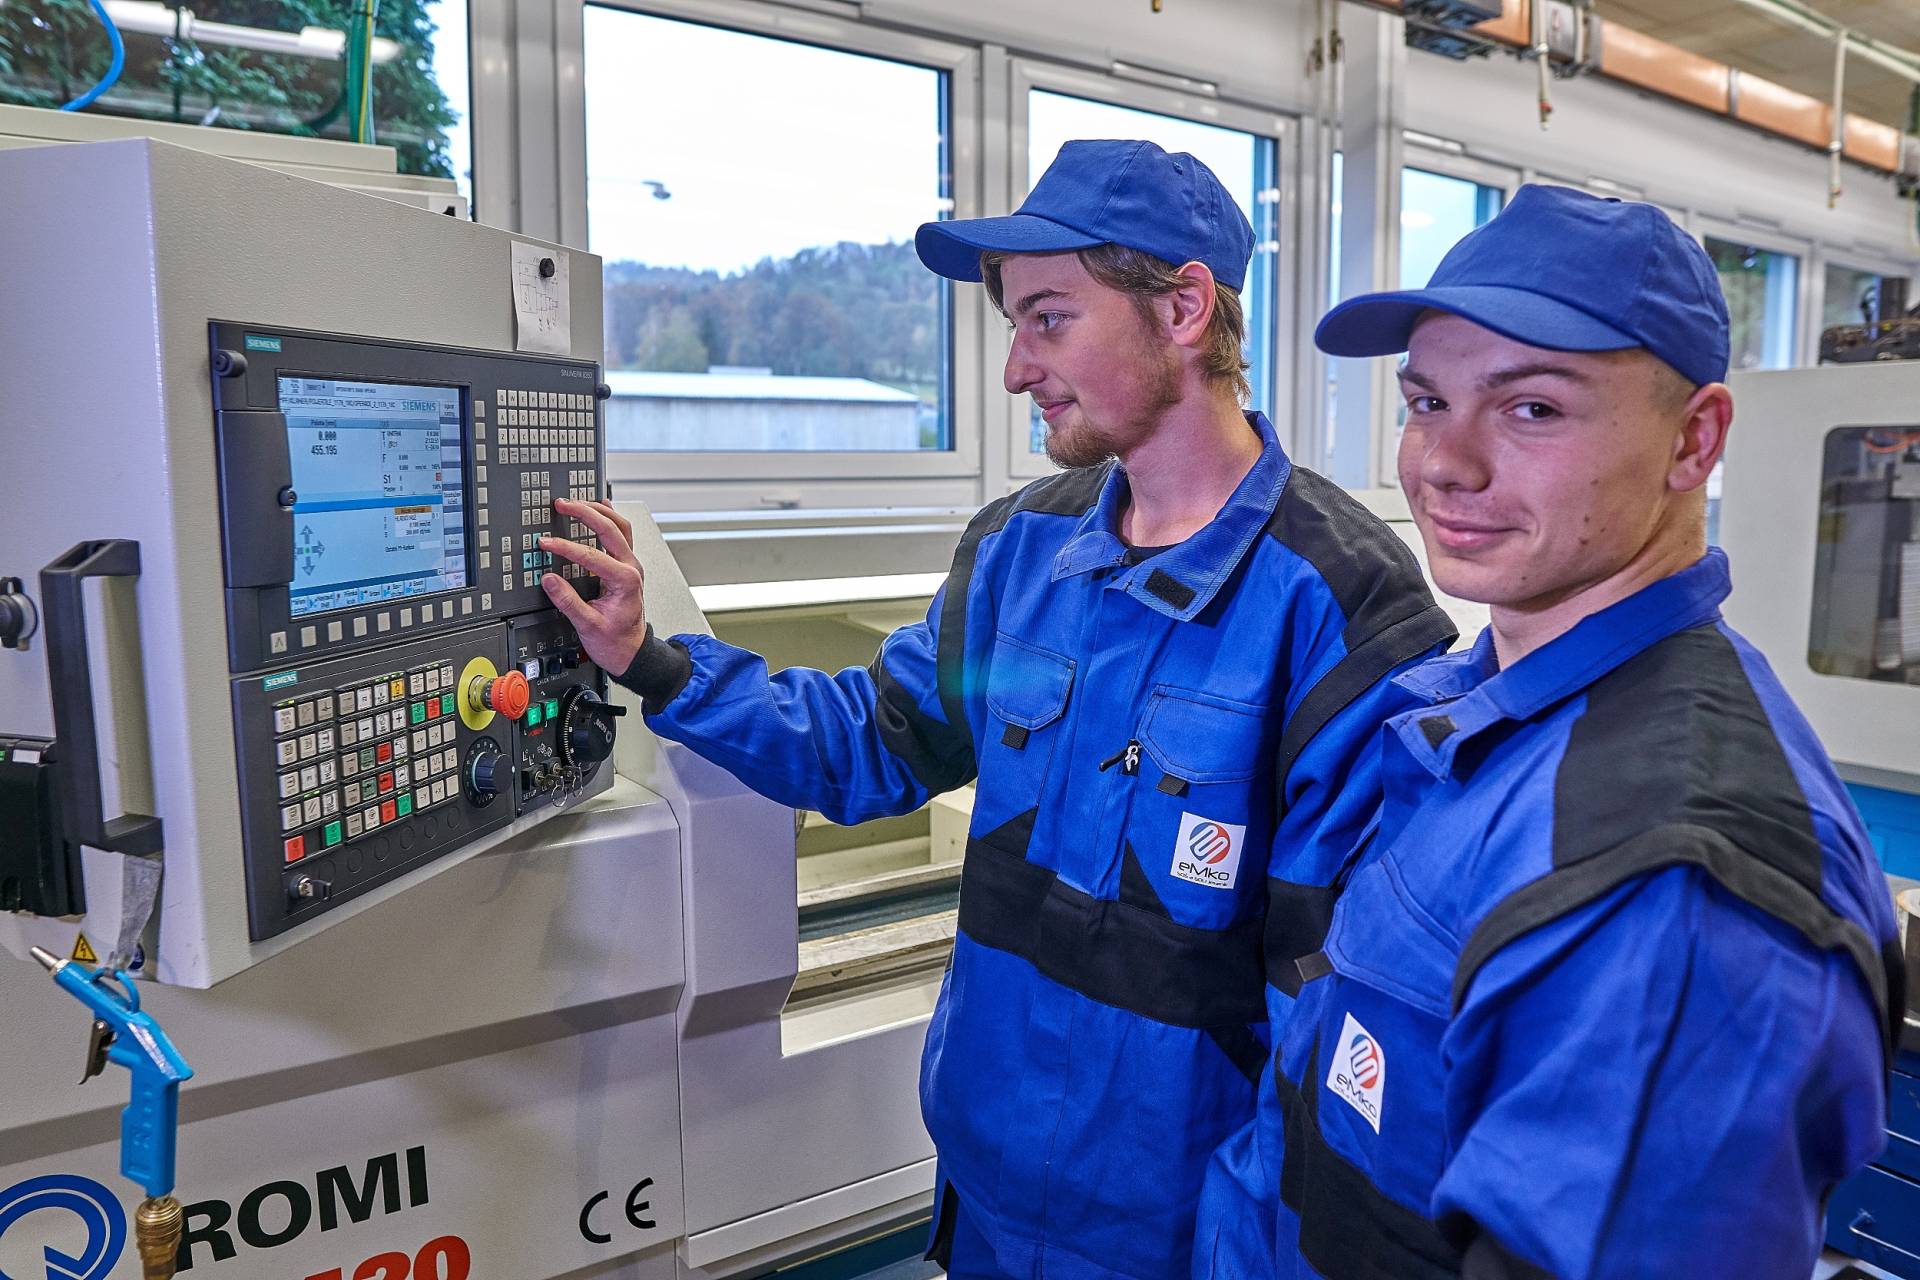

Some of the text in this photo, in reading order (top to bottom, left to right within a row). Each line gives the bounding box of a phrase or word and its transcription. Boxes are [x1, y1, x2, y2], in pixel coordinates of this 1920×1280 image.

[401, 401, 437, 411] SIEMENS
[311, 444, 338, 456] 455.195
[265, 673, 297, 688] SIEMENS
[176, 1145, 429, 1272] ROMI
